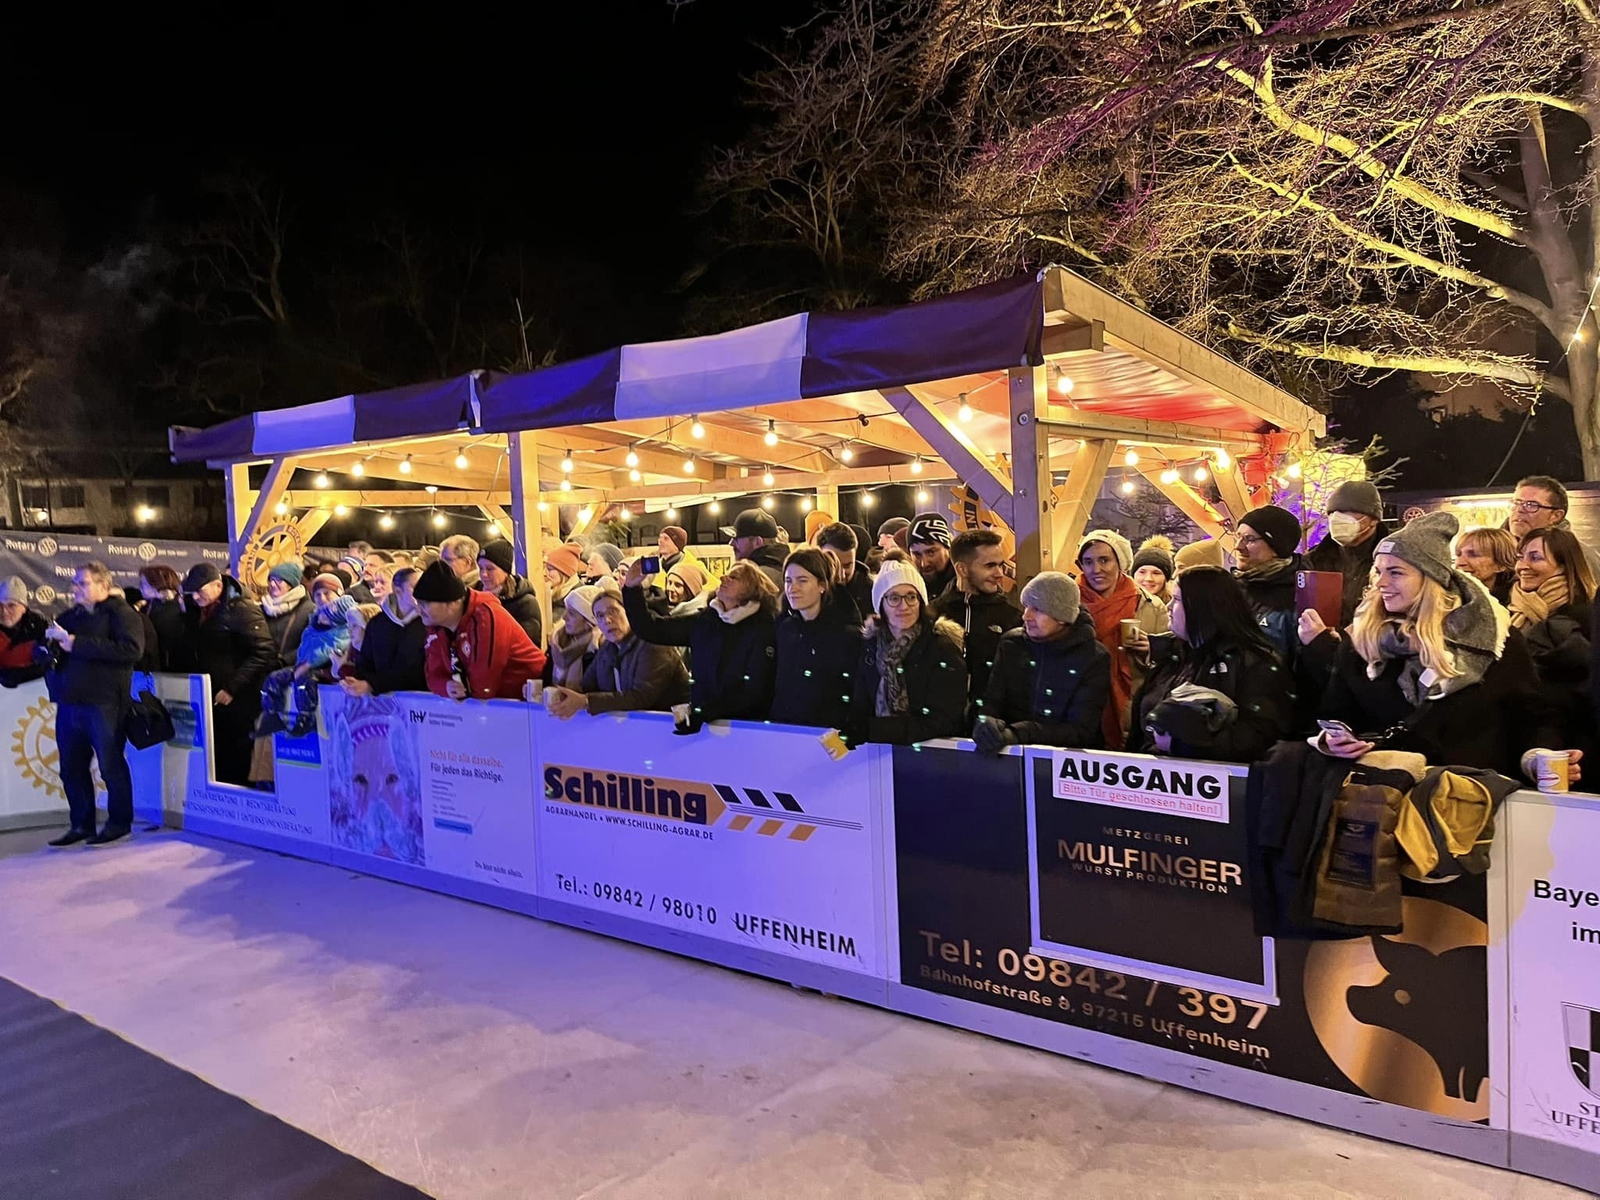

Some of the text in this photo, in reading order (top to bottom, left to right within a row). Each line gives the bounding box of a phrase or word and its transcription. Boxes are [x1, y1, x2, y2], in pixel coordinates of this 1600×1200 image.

[5, 539, 36, 552] Rotary
[108, 544, 137, 557] Rotary
[203, 549, 230, 560] Rotary
[442, 763, 460, 776] jeden
[461, 766, 473, 777] das
[1059, 757, 1222, 800] AUSGANG
[544, 766, 708, 825] Schilling
[1063, 783, 1218, 815] Bitte Tür geschlossen halten!
[545, 805, 714, 841] AGRARHANDEL WWW.SCHILLING-AGRAR.DE
[1103, 826, 1190, 846] METZGEREI
[1057, 838, 1243, 886] MULFINGER
[556, 873, 588, 896] Tel.:
[593, 882, 643, 908] 09842
[662, 897, 717, 925] 98010
[735, 912, 856, 957] UFFENHEIM
[919, 930, 983, 969] Tel:
[997, 948, 1128, 1001] 09842
[1177, 986, 1269, 1030] 397
[920, 964, 1053, 1007] Bahnhofstraße
[1082, 1002, 1145, 1028] 97215
[1151, 1017, 1271, 1060] Uffenheim
